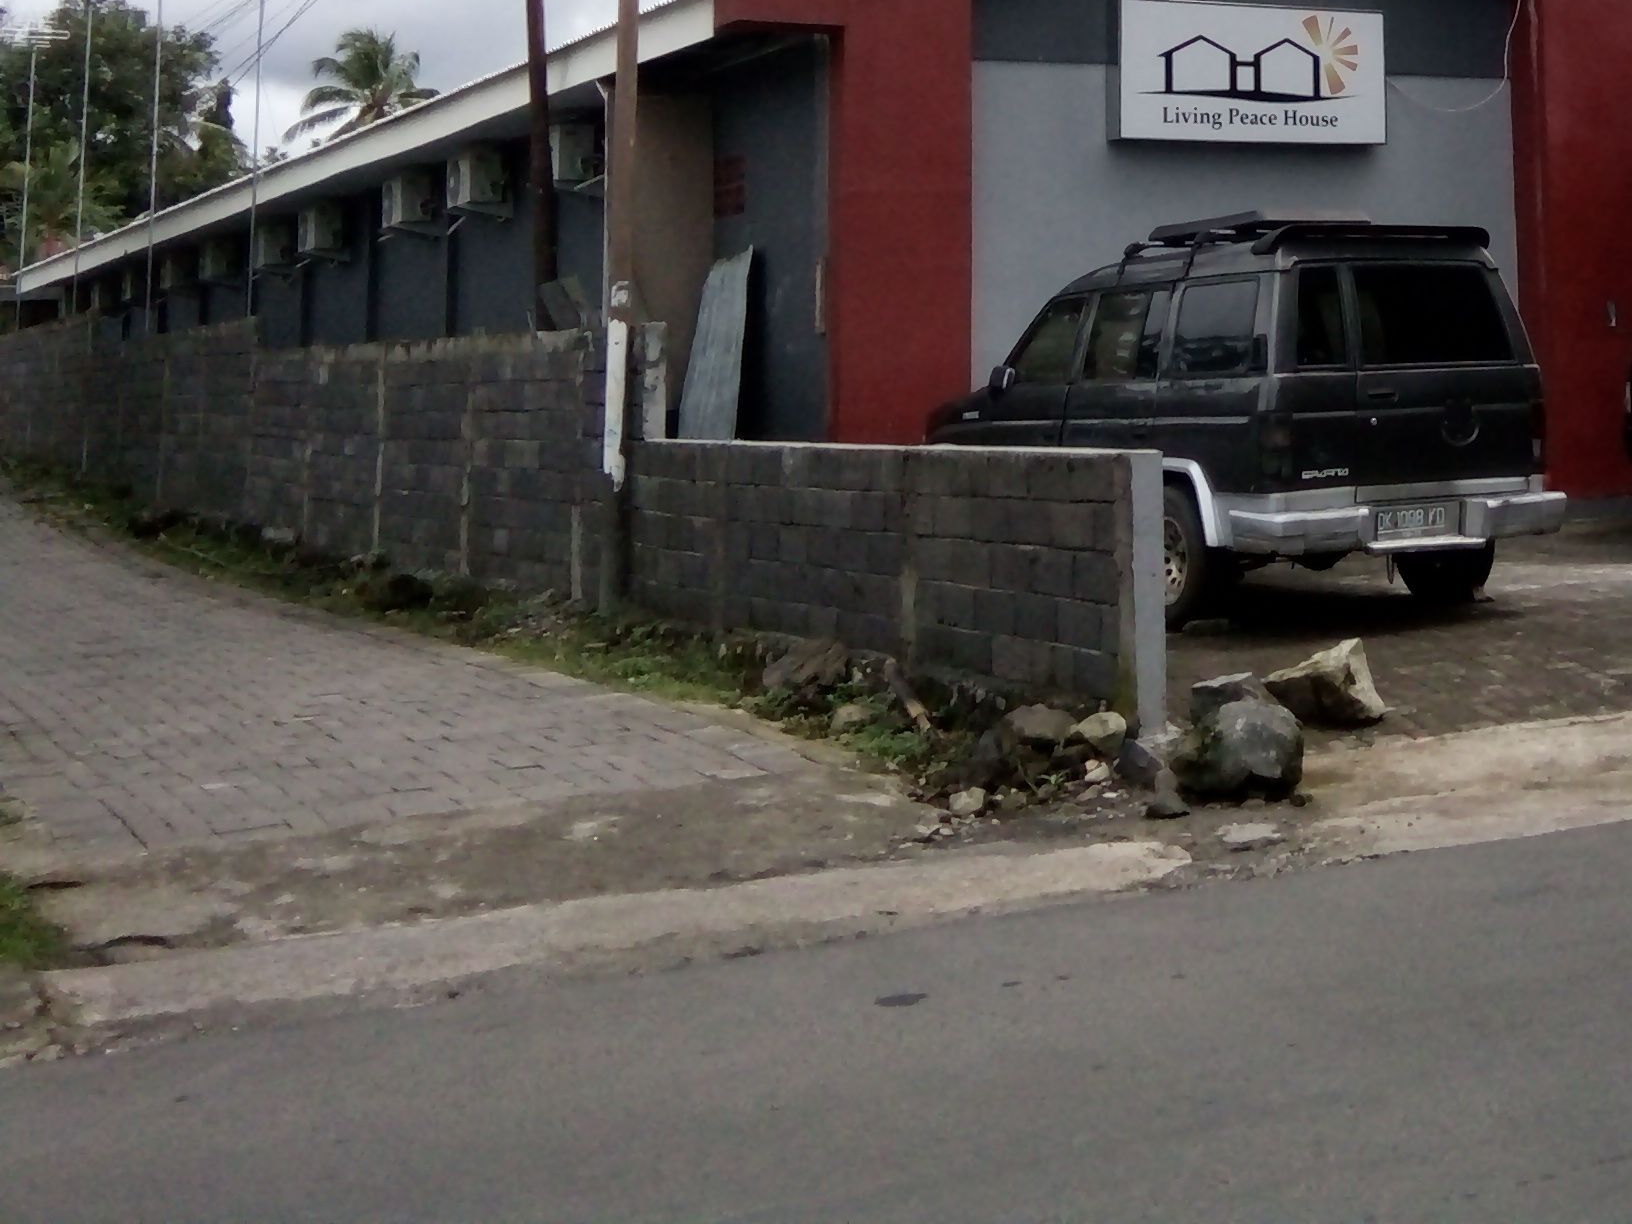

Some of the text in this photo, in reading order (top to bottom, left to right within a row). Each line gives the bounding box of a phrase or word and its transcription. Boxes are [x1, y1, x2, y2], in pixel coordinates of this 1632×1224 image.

[1162, 107, 1338, 129] Living Peace House
